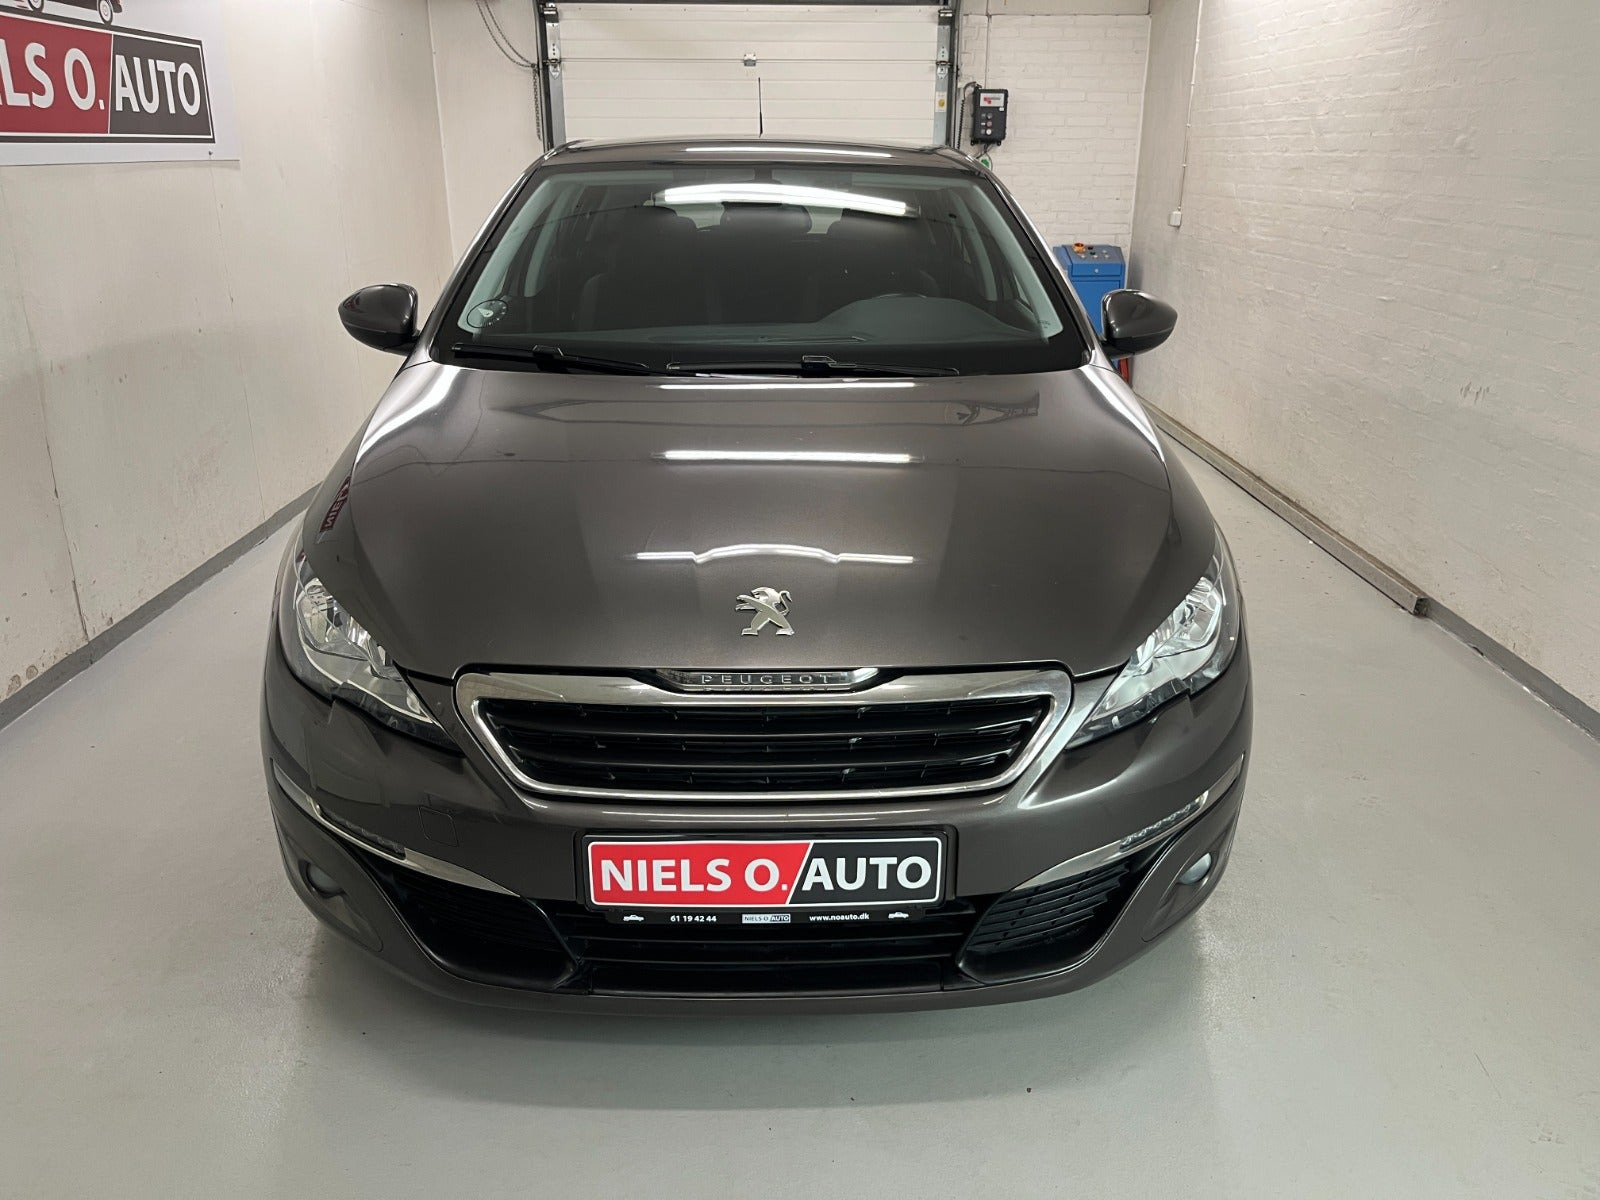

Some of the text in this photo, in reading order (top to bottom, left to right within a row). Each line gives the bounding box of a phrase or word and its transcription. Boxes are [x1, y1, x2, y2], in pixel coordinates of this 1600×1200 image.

[0, 38, 201, 116] LS O. AUTO
[701, 673, 834, 685] PEUGEOT
[601, 856, 932, 892] NIELS O. AUTO
[809, 912, 870, 921] www.noauto.dk
